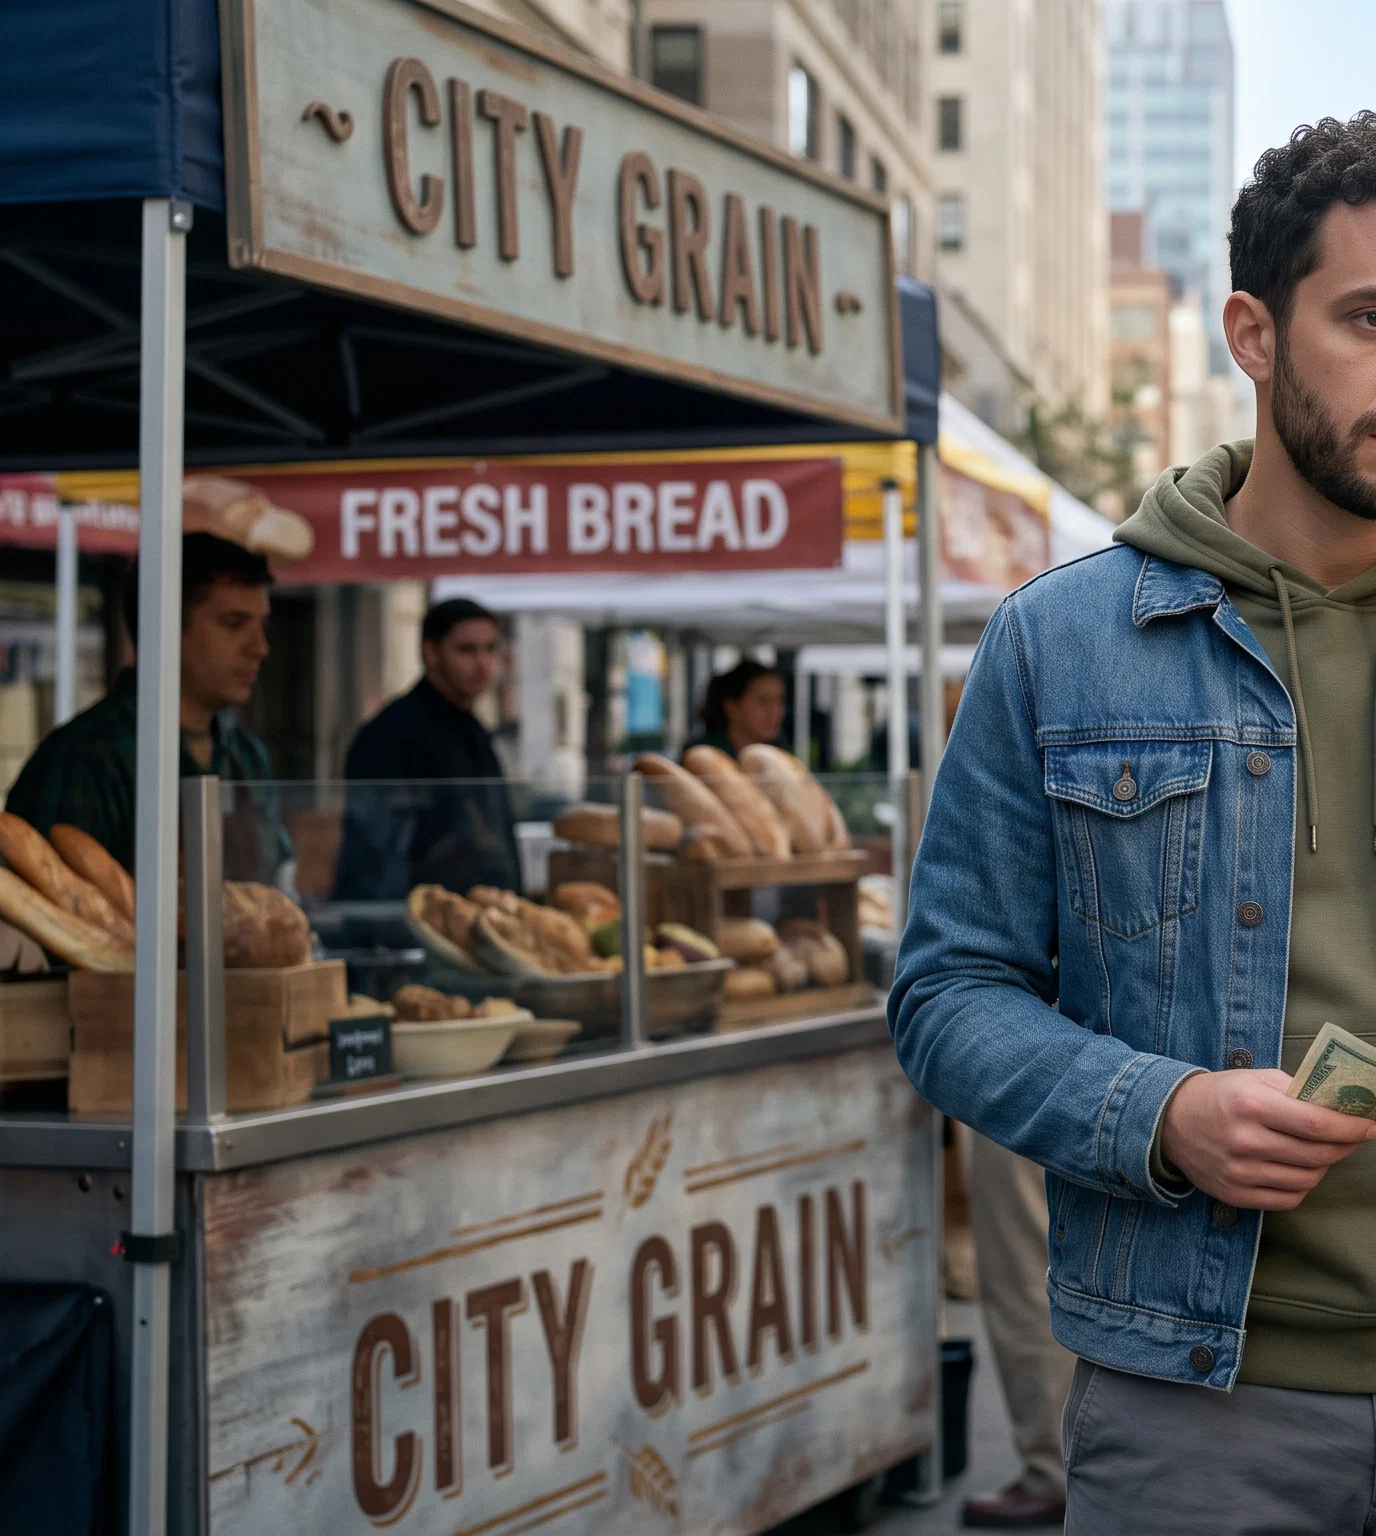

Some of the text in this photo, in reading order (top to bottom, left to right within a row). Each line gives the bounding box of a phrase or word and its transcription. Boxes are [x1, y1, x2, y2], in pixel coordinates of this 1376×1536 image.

[382, 57, 823, 355] CITY GRAIN
[340, 479, 790, 559] FRESH BREAD
[350, 1179, 871, 1527] CITY GRAIN
